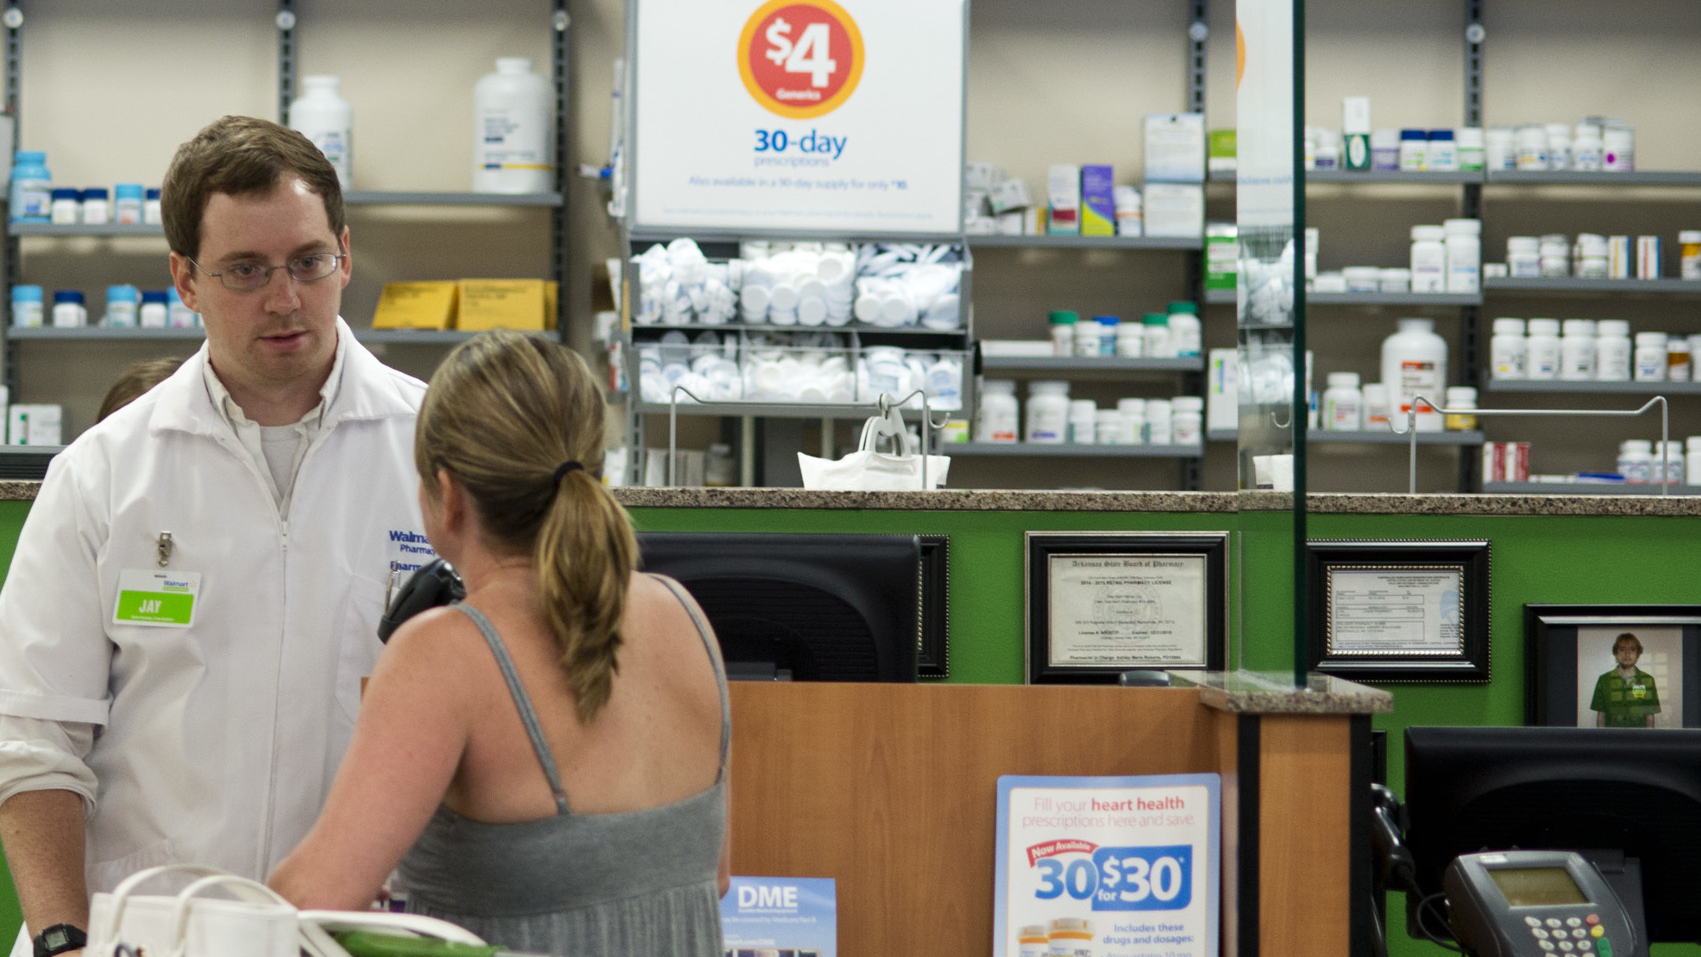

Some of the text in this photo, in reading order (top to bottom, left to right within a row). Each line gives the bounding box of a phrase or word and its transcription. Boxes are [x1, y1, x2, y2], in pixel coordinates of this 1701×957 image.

[765, 17, 837, 88] $4
[775, 87, 822, 101] Generics
[753, 129, 848, 160] 30-day
[753, 154, 830, 168] prescriptions
[389, 530, 431, 544] Walma
[138, 599, 162, 614] JAY
[1033, 796, 1185, 815] Fill your heart health
[1022, 811, 1196, 829] prescriptions here and save.
[1031, 840, 1092, 860] Now Available
[1034, 858, 1098, 901] 30
[1097, 888, 1116, 902] for
[737, 885, 799, 909] DME
[1113, 922, 1184, 933] Includes these
[1102, 933, 1194, 946] drugs and dosages:
